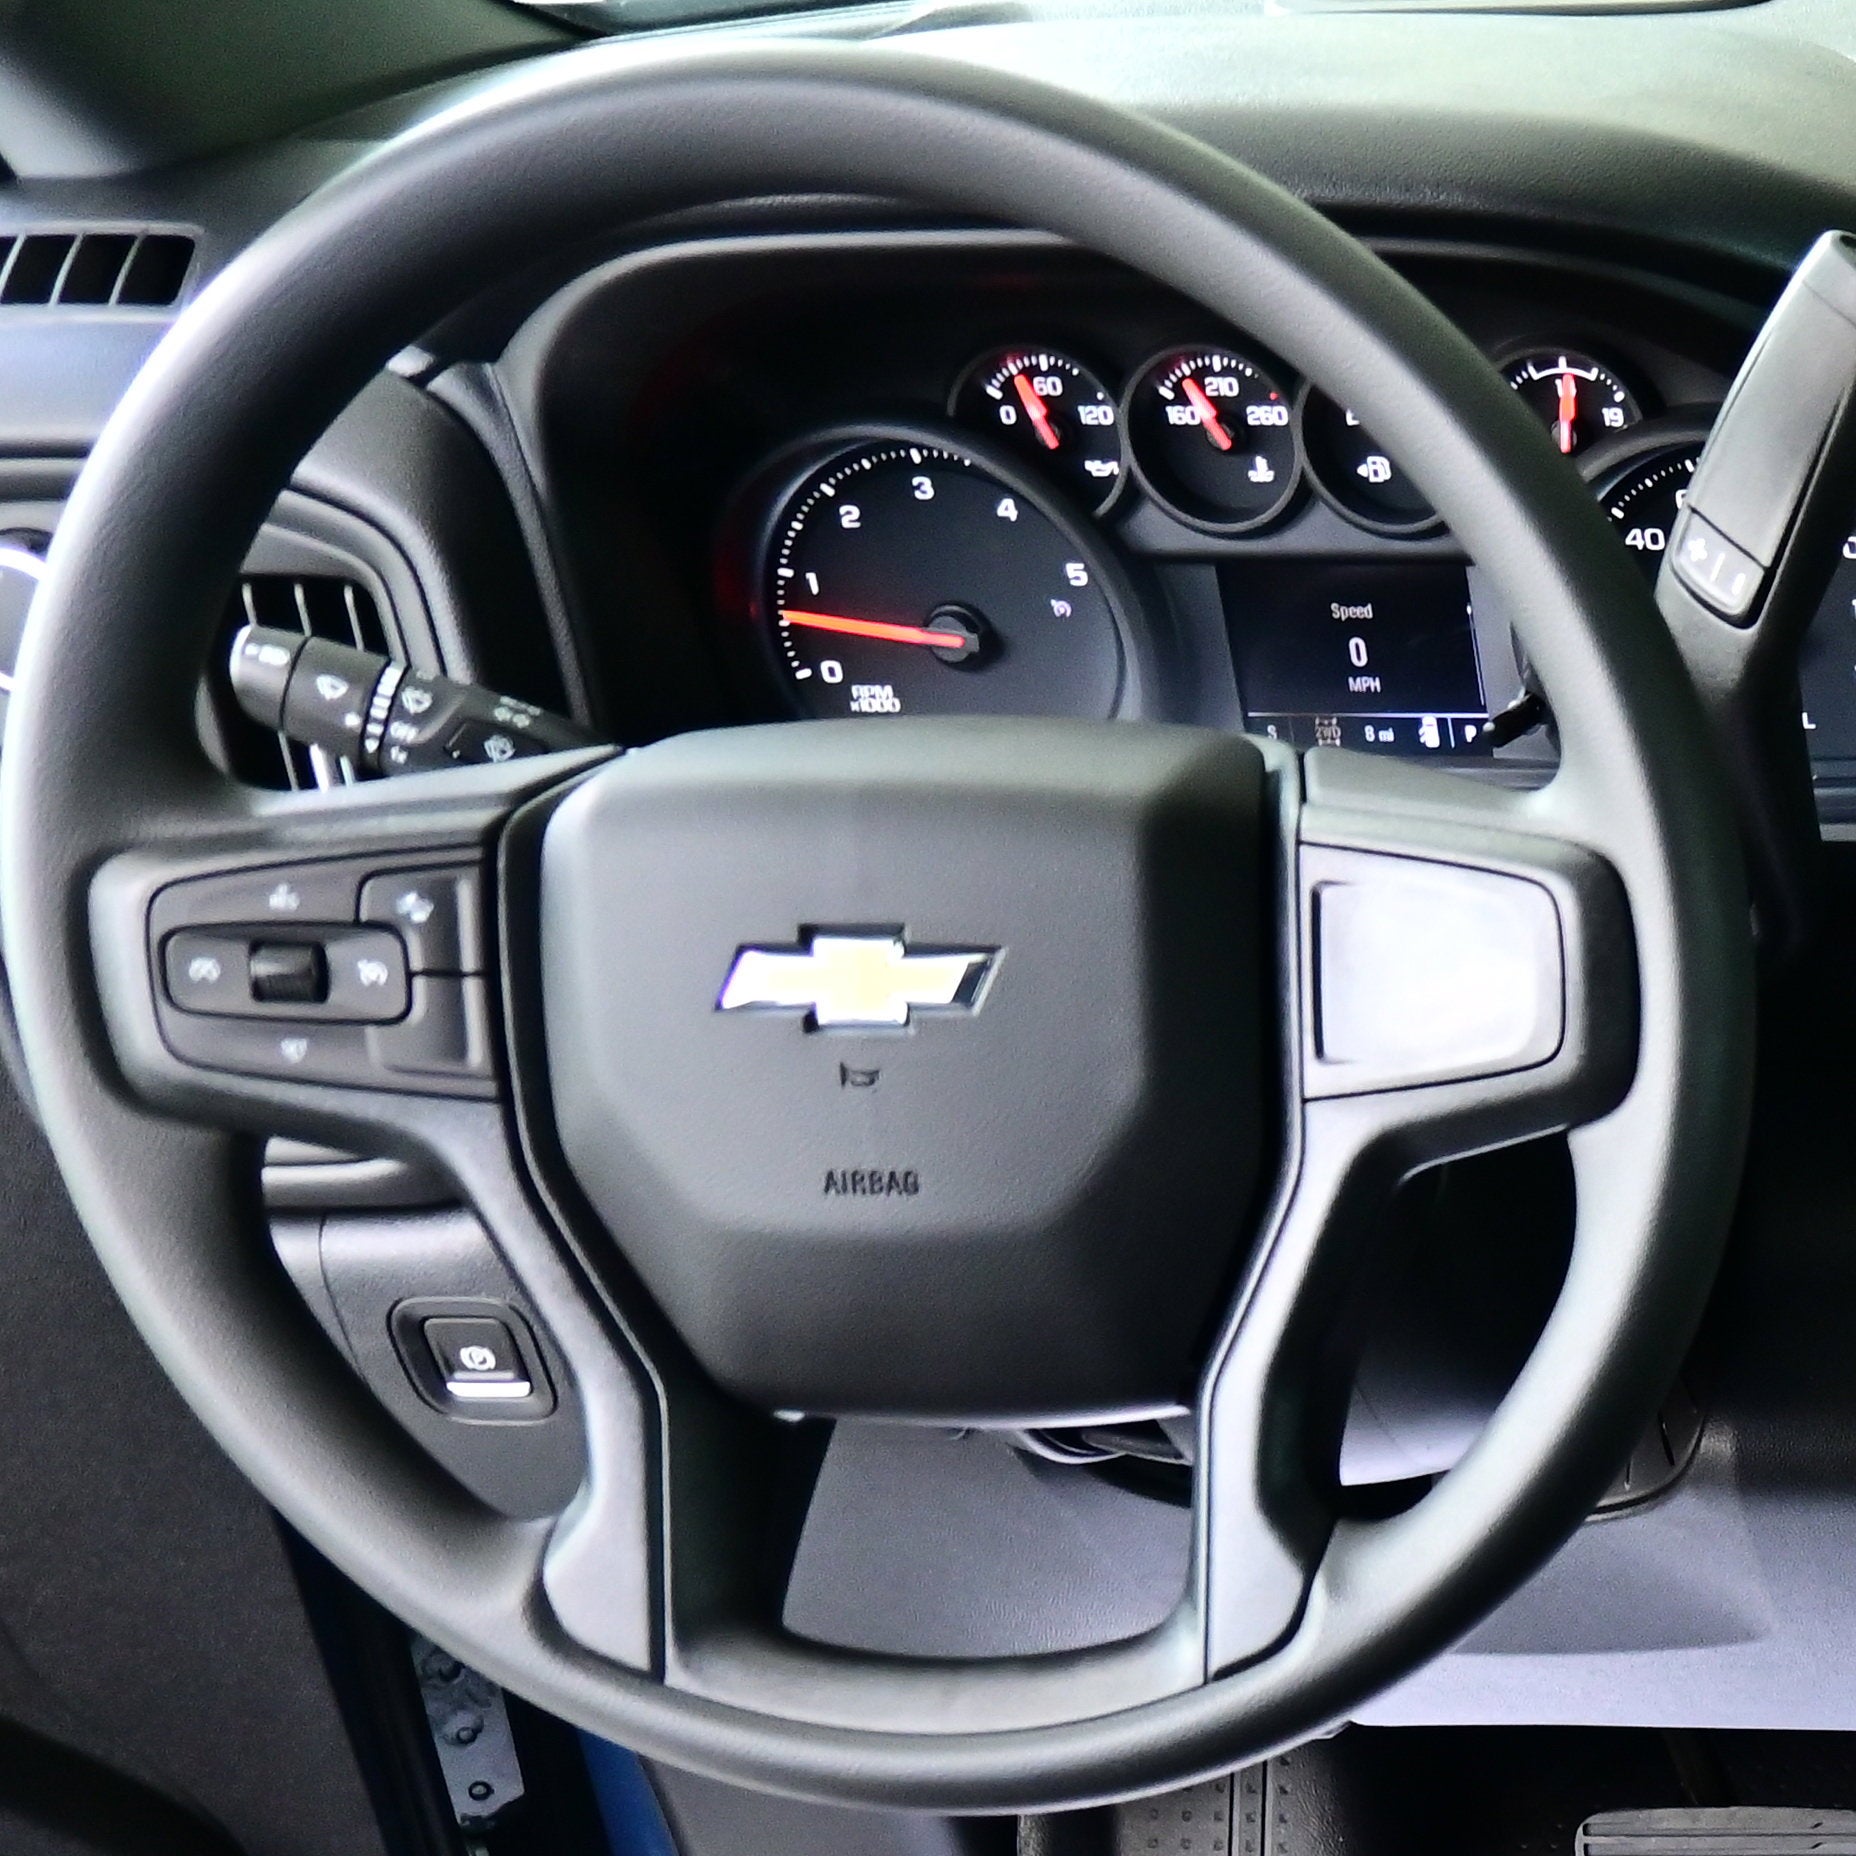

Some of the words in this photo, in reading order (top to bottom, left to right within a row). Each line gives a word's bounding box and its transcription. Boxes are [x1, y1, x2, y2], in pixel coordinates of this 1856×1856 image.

[1032, 376, 1064, 397] 60
[1204, 376, 1239, 397] 210
[999, 405, 1017, 425] 0
[1078, 405, 1114, 426] 120
[1165, 405, 1202, 426] 160
[1246, 405, 1289, 427] 260
[1601, 406, 1625, 428] 19
[911, 475, 936, 501] 3
[838, 504, 862, 529] 2
[996, 497, 1019, 522] 4
[1624, 527, 1666, 551] 40
[804, 571, 820, 596] 1
[1065, 562, 1089, 587] 5
[1330, 602, 1374, 622] Speed
[1348, 636, 1369, 668] 0
[820, 660, 844, 684] 0
[851, 685, 894, 700] RPM
[1348, 675, 1382, 694] MPH
[1378, 727, 1395, 743] mi
[823, 1169, 920, 1198] AIRBAG
